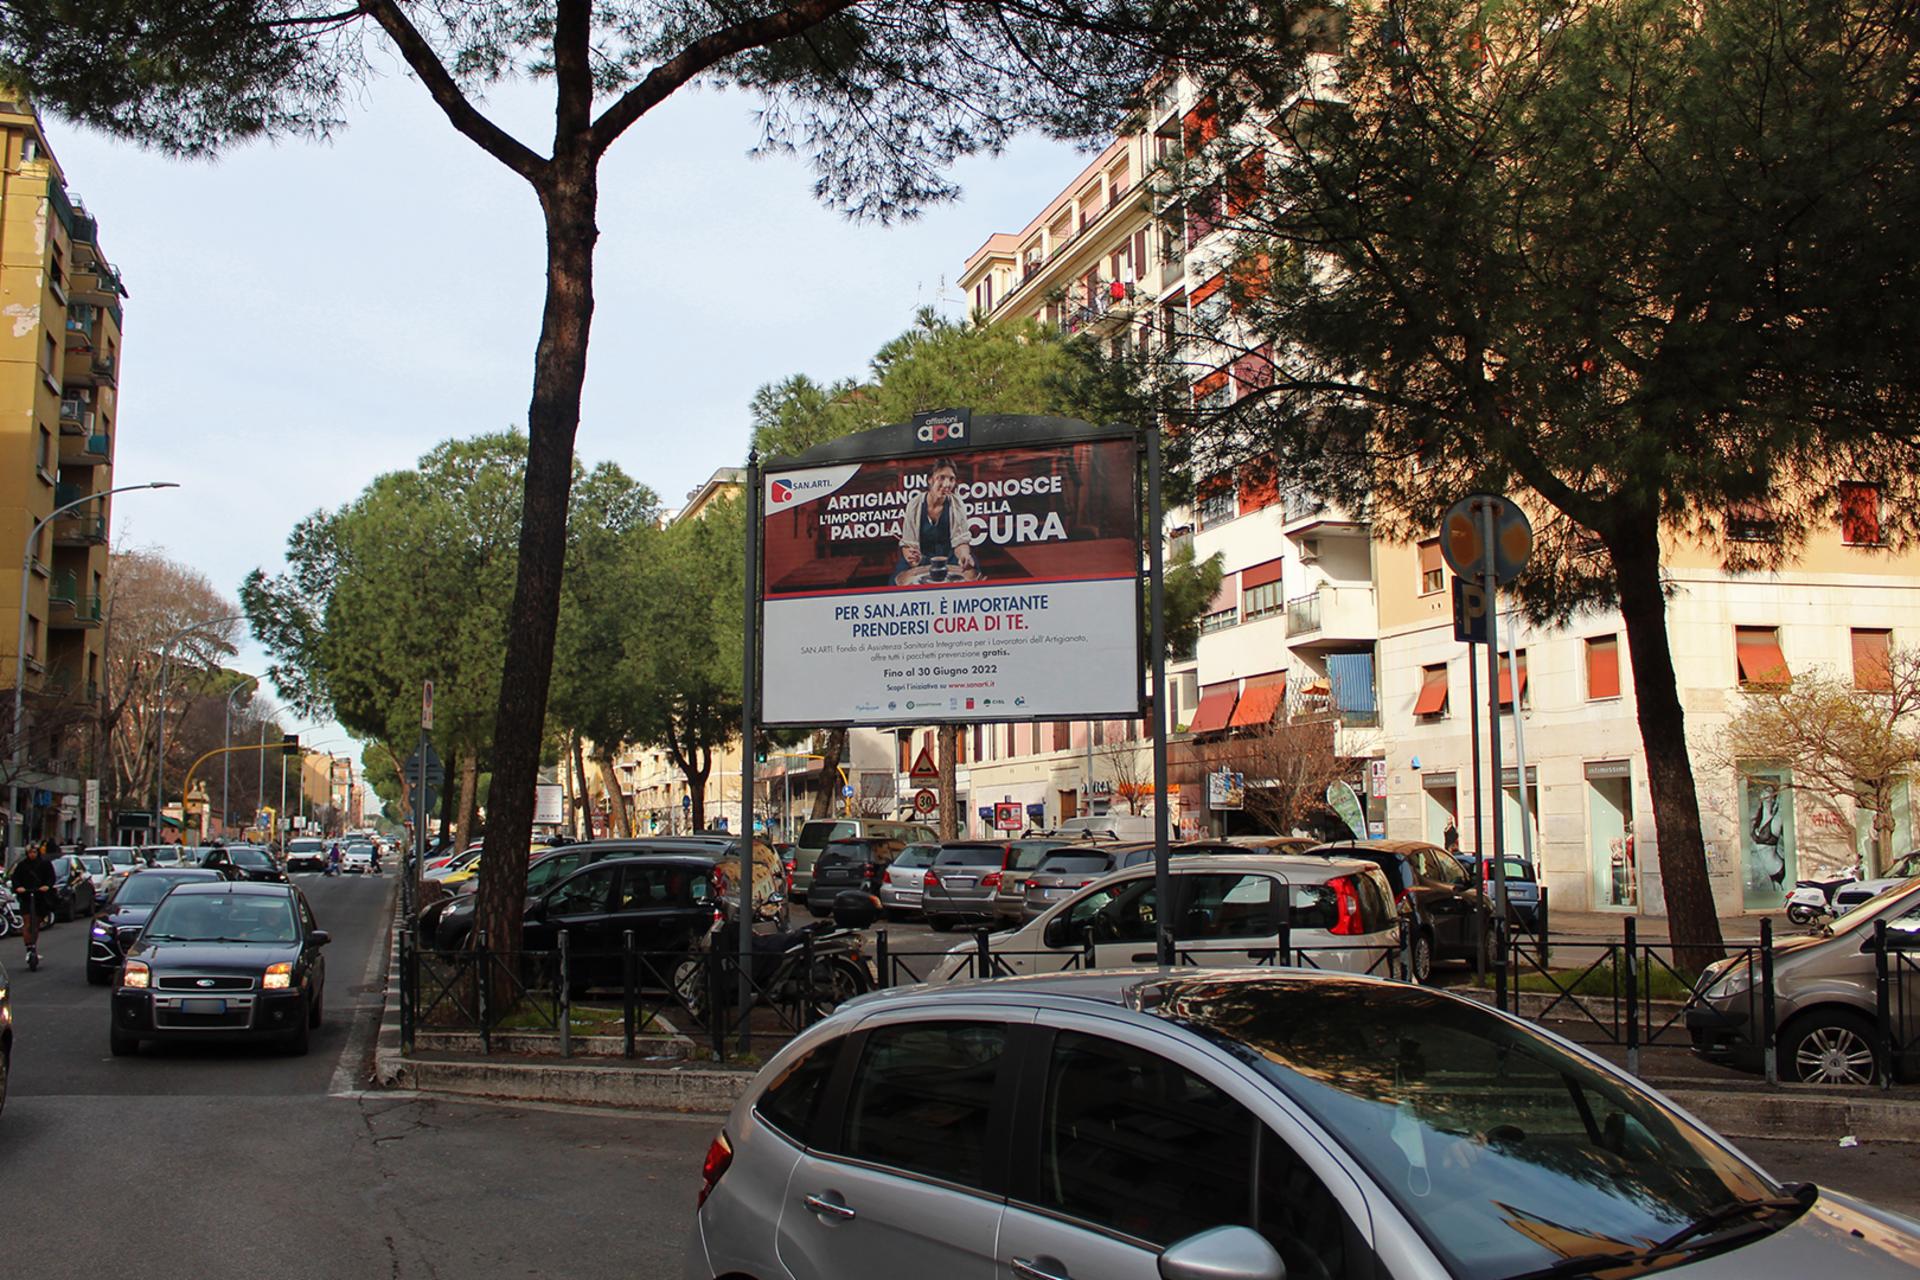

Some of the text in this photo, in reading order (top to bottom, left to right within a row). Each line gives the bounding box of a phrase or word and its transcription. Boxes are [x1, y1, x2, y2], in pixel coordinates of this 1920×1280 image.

[925, 415, 958, 425] affissioni
[917, 422, 964, 443] apa
[792, 480, 832, 490] SAN.ARTI.
[903, 473, 928, 489] UN
[957, 475, 1062, 500] CONOSCE
[819, 500, 1012, 526] L'IMPORTANZA DELLA
[830, 511, 1068, 546] PAROLA CURA
[835, 594, 1048, 620] PER SAN.ARTI. È IMPORTANTE
[853, 613, 1029, 637] PRENDERSI CURA DI TE.
[836, 643, 857, 653] Fondo
[859, 643, 865, 652] di
[867, 642, 902, 652] Assistenza
[903, 641, 934, 651] Sanitaria
[936, 638, 972, 650] Integrativa
[974, 639, 985, 648] per
[992, 636, 1028, 646] Lavoratori
[870, 652, 886, 662] offre
[888, 650, 900, 660] tutti
[906, 649, 937, 661] pacchetti
[938, 650, 980, 660] prevenzione
[982, 647, 1010, 658] gratis.
[883, 664, 998, 678] Fino al 30 Giugno 2022
[886, 683, 905, 692] Scopri
[919, 796, 932, 807] 30
